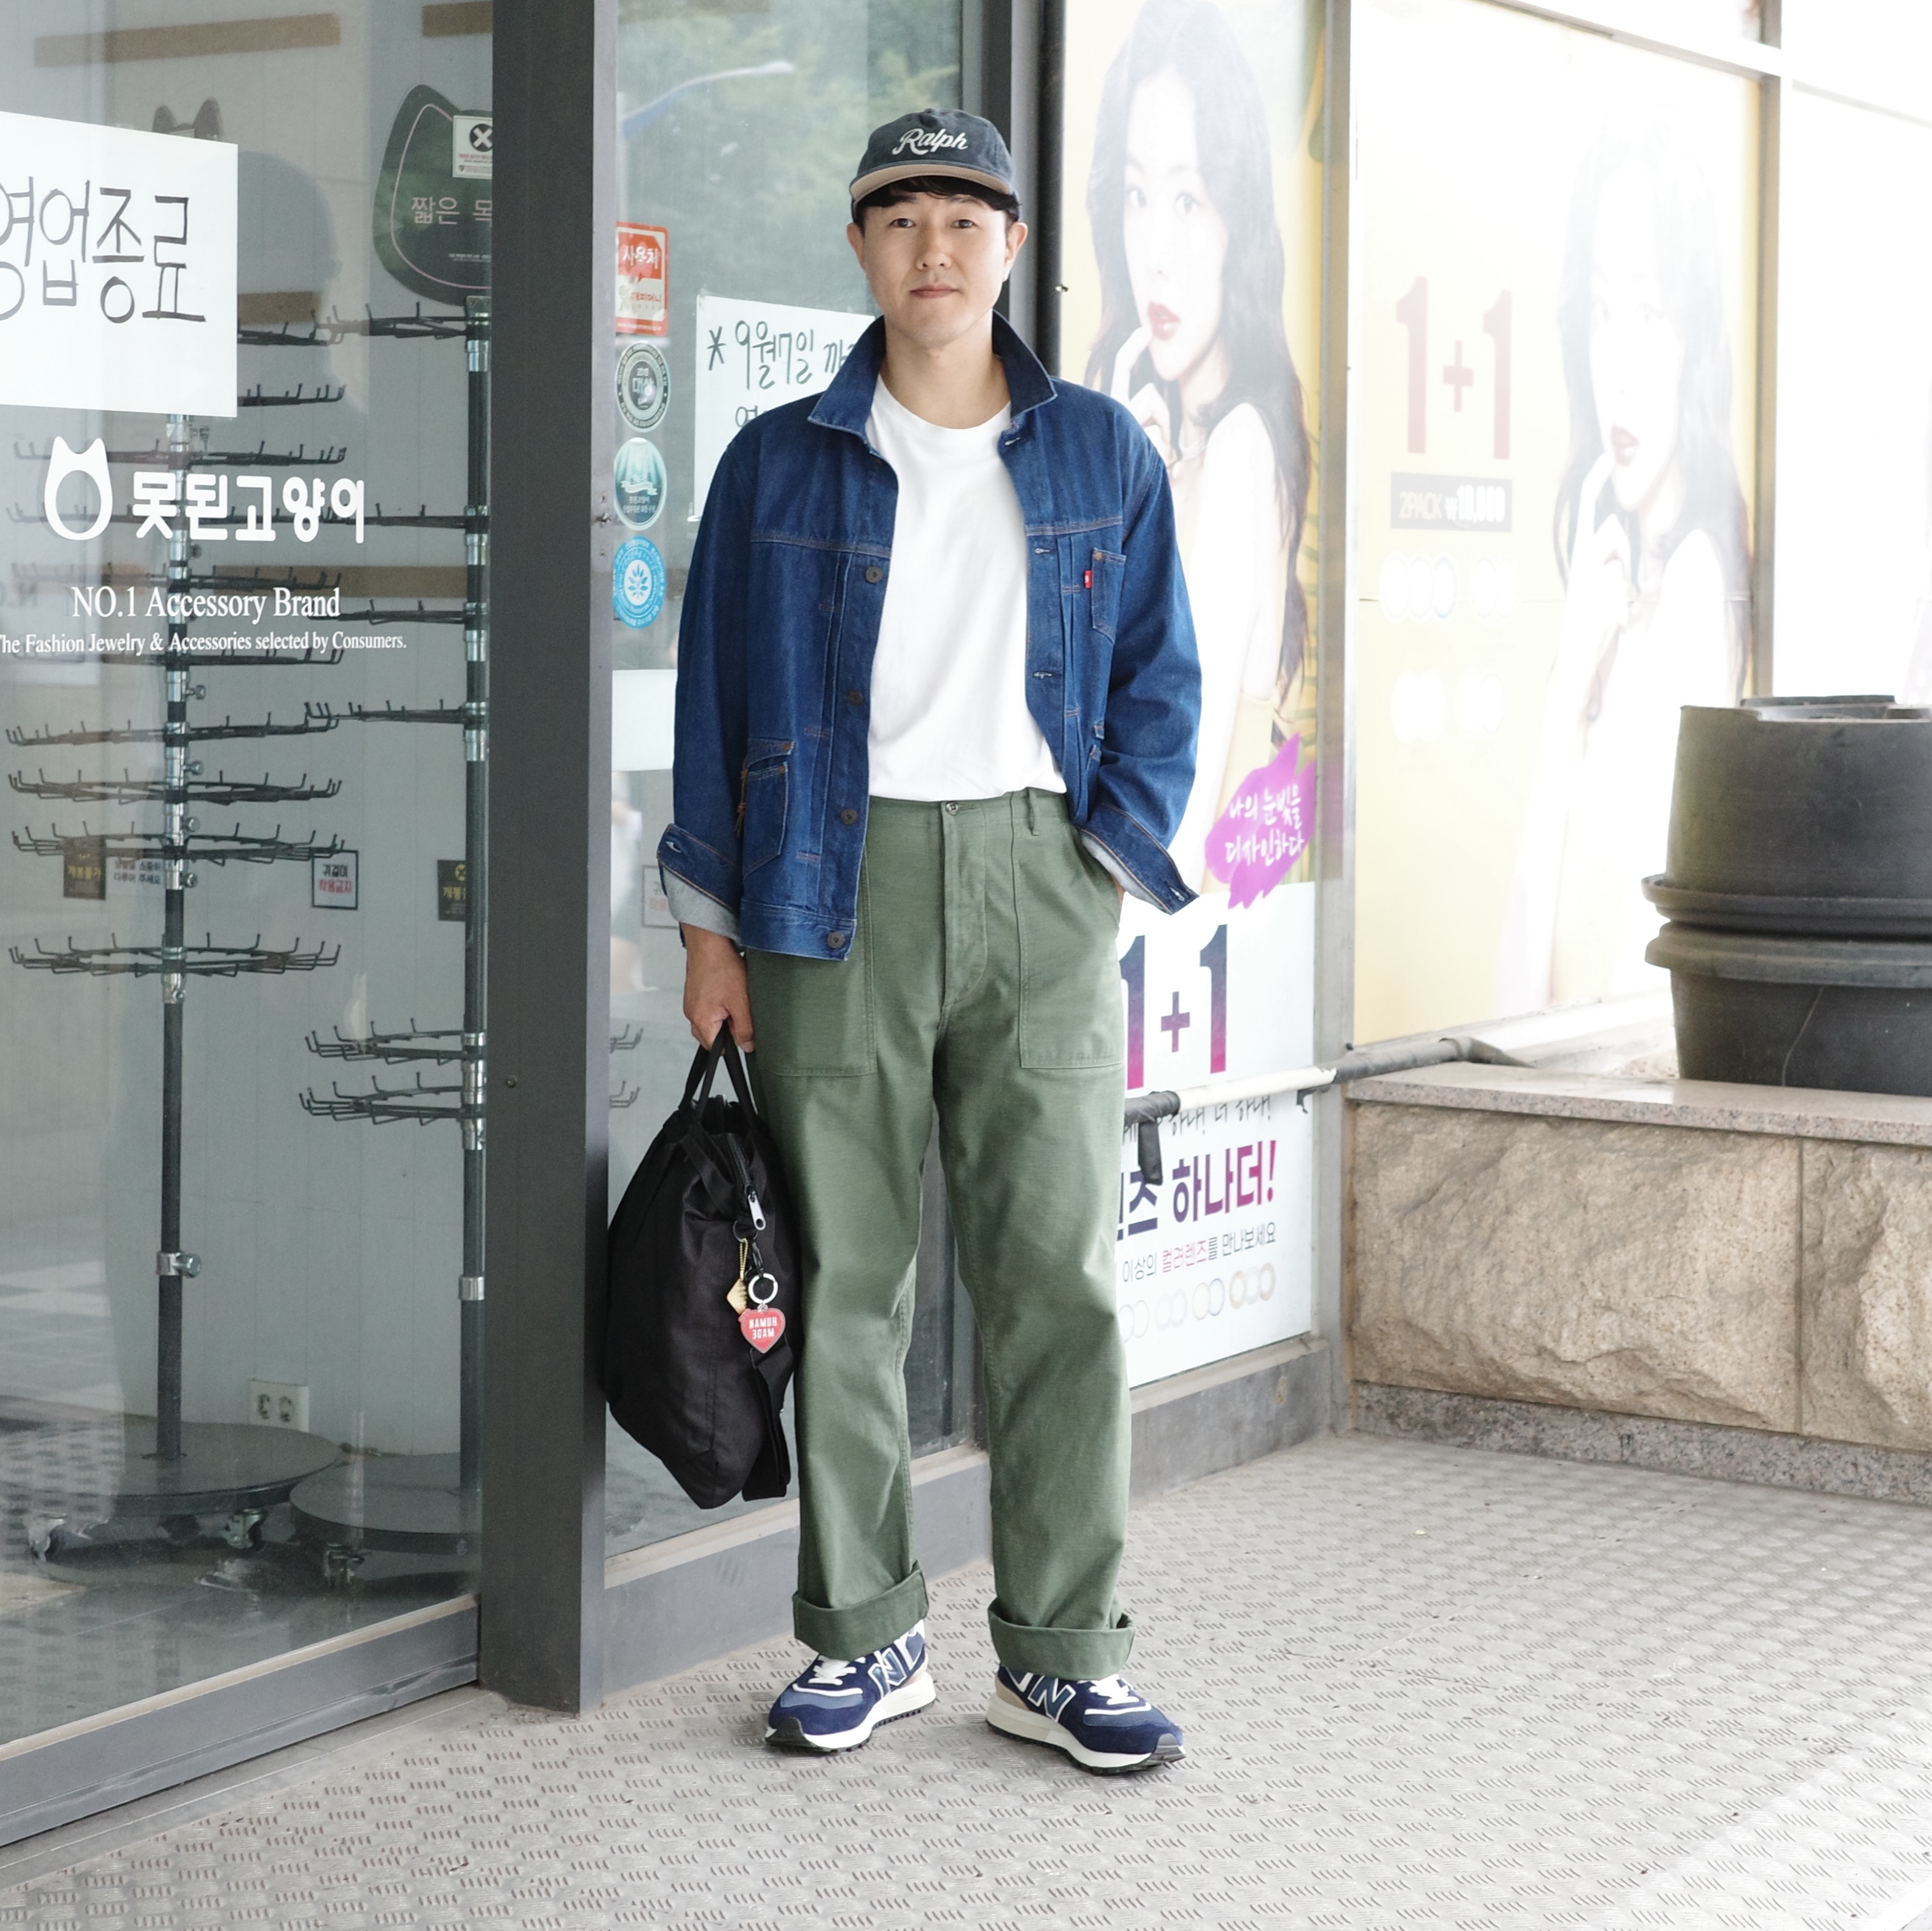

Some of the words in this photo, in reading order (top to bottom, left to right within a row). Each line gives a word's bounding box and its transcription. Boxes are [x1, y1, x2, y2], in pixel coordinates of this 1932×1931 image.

[892, 128, 968, 155] Ralph
[411, 197, 460, 225] 짧은
[0, 176, 206, 323] 영업종료
[623, 245, 658, 270] 사용처
[823, 339, 855, 374] 까
[1396, 276, 1513, 460] 1+1
[133, 471, 364, 543] 못된고양이
[71, 586, 137, 617] NO.1
[145, 586, 267, 625] Accessory
[273, 587, 341, 617] Brand
[25, 633, 85, 653] Fashion
[88, 633, 146, 656] Jewelry
[149, 632, 164, 652] &
[169, 632, 252, 652] Accessories
[255, 632, 309, 650] selected
[312, 632, 329, 654] by
[332, 631, 407, 649] Consumers.
[1230, 793, 1259, 821] 나의
[1263, 784, 1303, 830] 눈빛을
[1225, 828, 1305, 867] 디자인하다
[443, 886, 466, 901] 개봉
[1119, 924, 1228, 1090] 1+1
[1172, 1140, 1276, 1223] 하나더!
[1123, 1253, 1157, 1282] 이상의
[1162, 1236, 1218, 1273] 컬러렌즈를
[1222, 1221, 1276, 1257] 만나보세요
